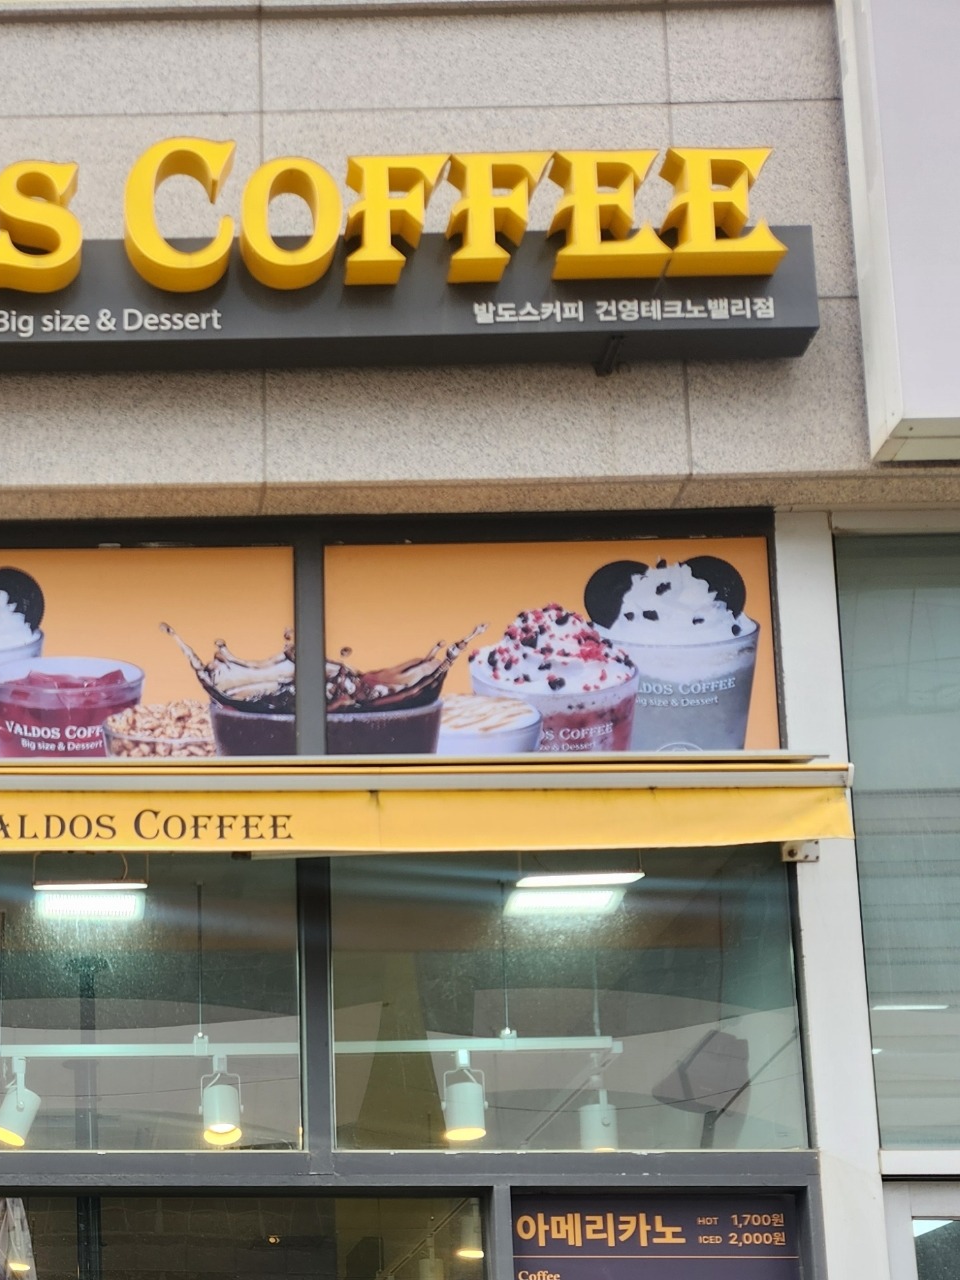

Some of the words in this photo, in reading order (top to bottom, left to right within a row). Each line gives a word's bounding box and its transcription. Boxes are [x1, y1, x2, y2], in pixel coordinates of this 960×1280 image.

[123, 136, 789, 293] COFFEE
[473, 301, 584, 323] 발도스커피
[595, 297, 775, 322] 건영테크노밸리점
[41, 311, 91, 334] size
[96, 309, 117, 331] &
[122, 308, 222, 332] Dessert
[679, 678, 736, 694] COFFEE
[681, 696, 719, 707] Dessert
[4, 721, 61, 740] VALDOS
[65, 725, 104, 740] COFF
[559, 722, 614, 741] COFFEE
[21, 738, 36, 750] Big
[36, 740, 55, 751] size
[57, 741, 66, 751] &
[67, 739, 104, 751] Dessert
[133, 808, 295, 841] COFFEE
[517, 1213, 687, 1247] 아메리카노
[697, 1217, 719, 1226] HOT
[730, 1213, 785, 1229] 1,700원
[698, 1235, 723, 1244] ICED
[728, 1232, 786, 1247] 2,000원
